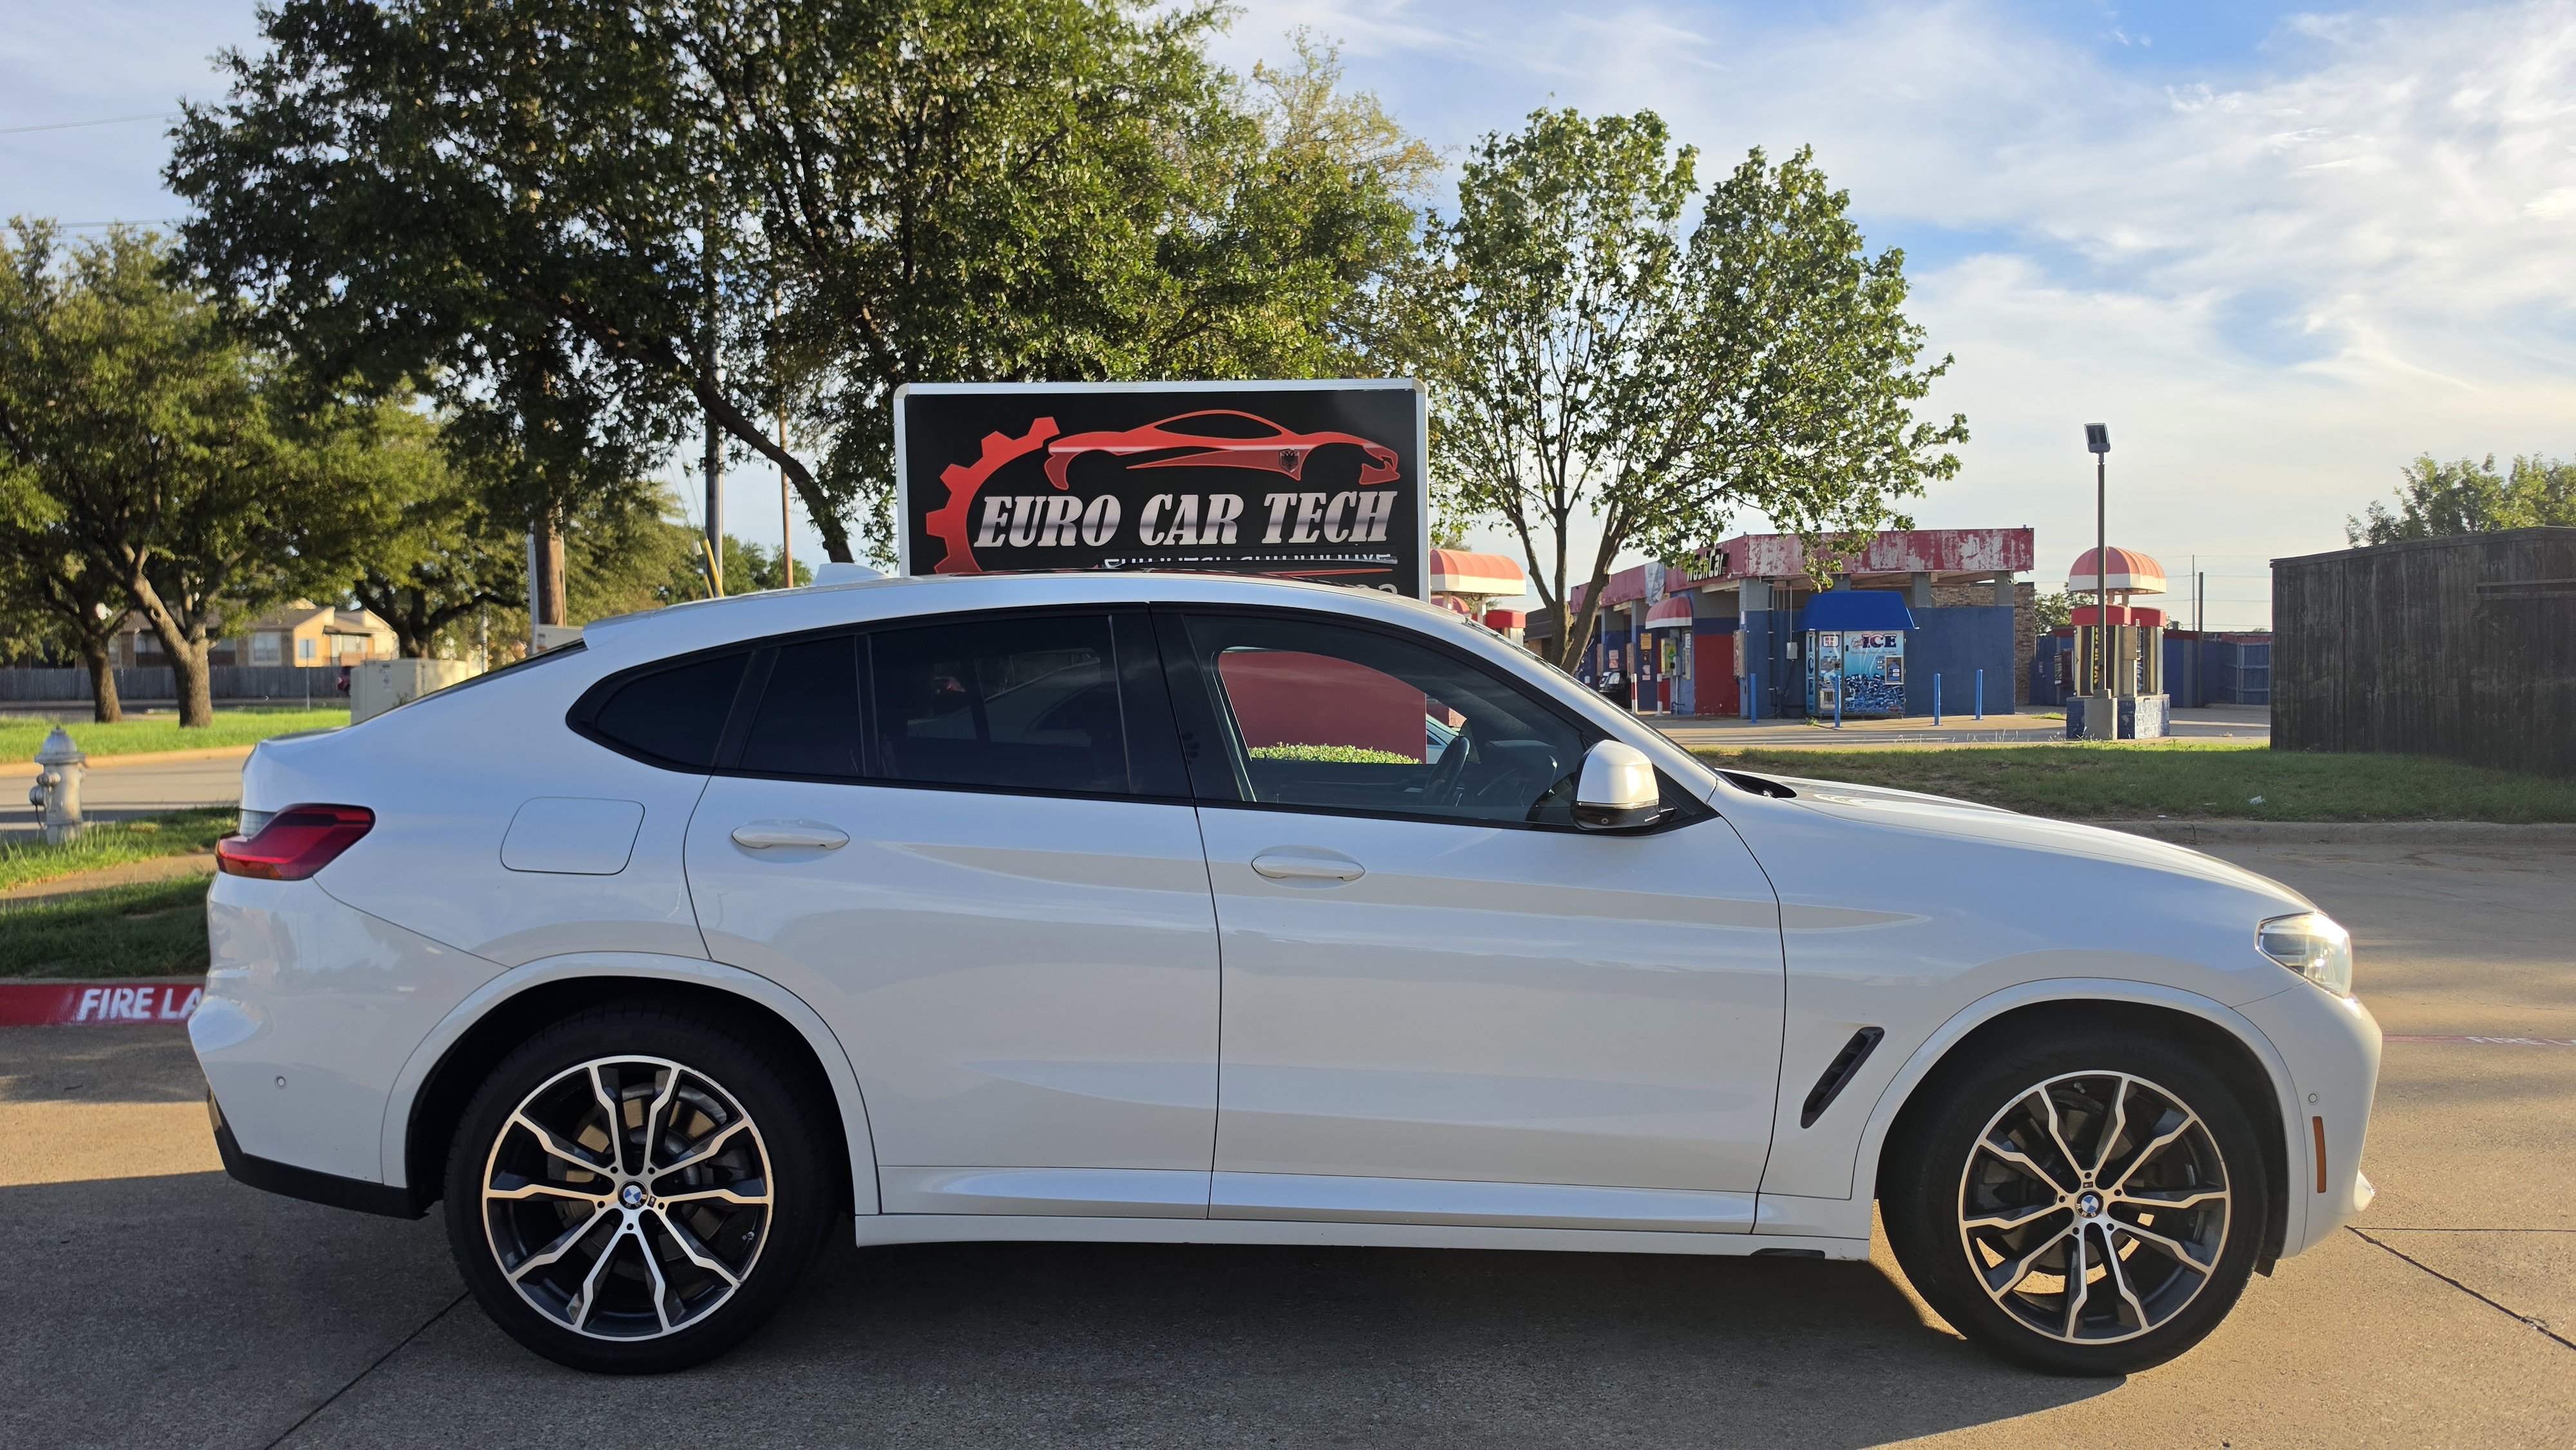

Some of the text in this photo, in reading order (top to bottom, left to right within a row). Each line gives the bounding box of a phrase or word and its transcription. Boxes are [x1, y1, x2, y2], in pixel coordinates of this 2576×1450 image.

[974, 491, 1397, 547] EURO CAR TECH
[1862, 634, 1897, 648] ICE
[77, 987, 155, 1021] FIRE
